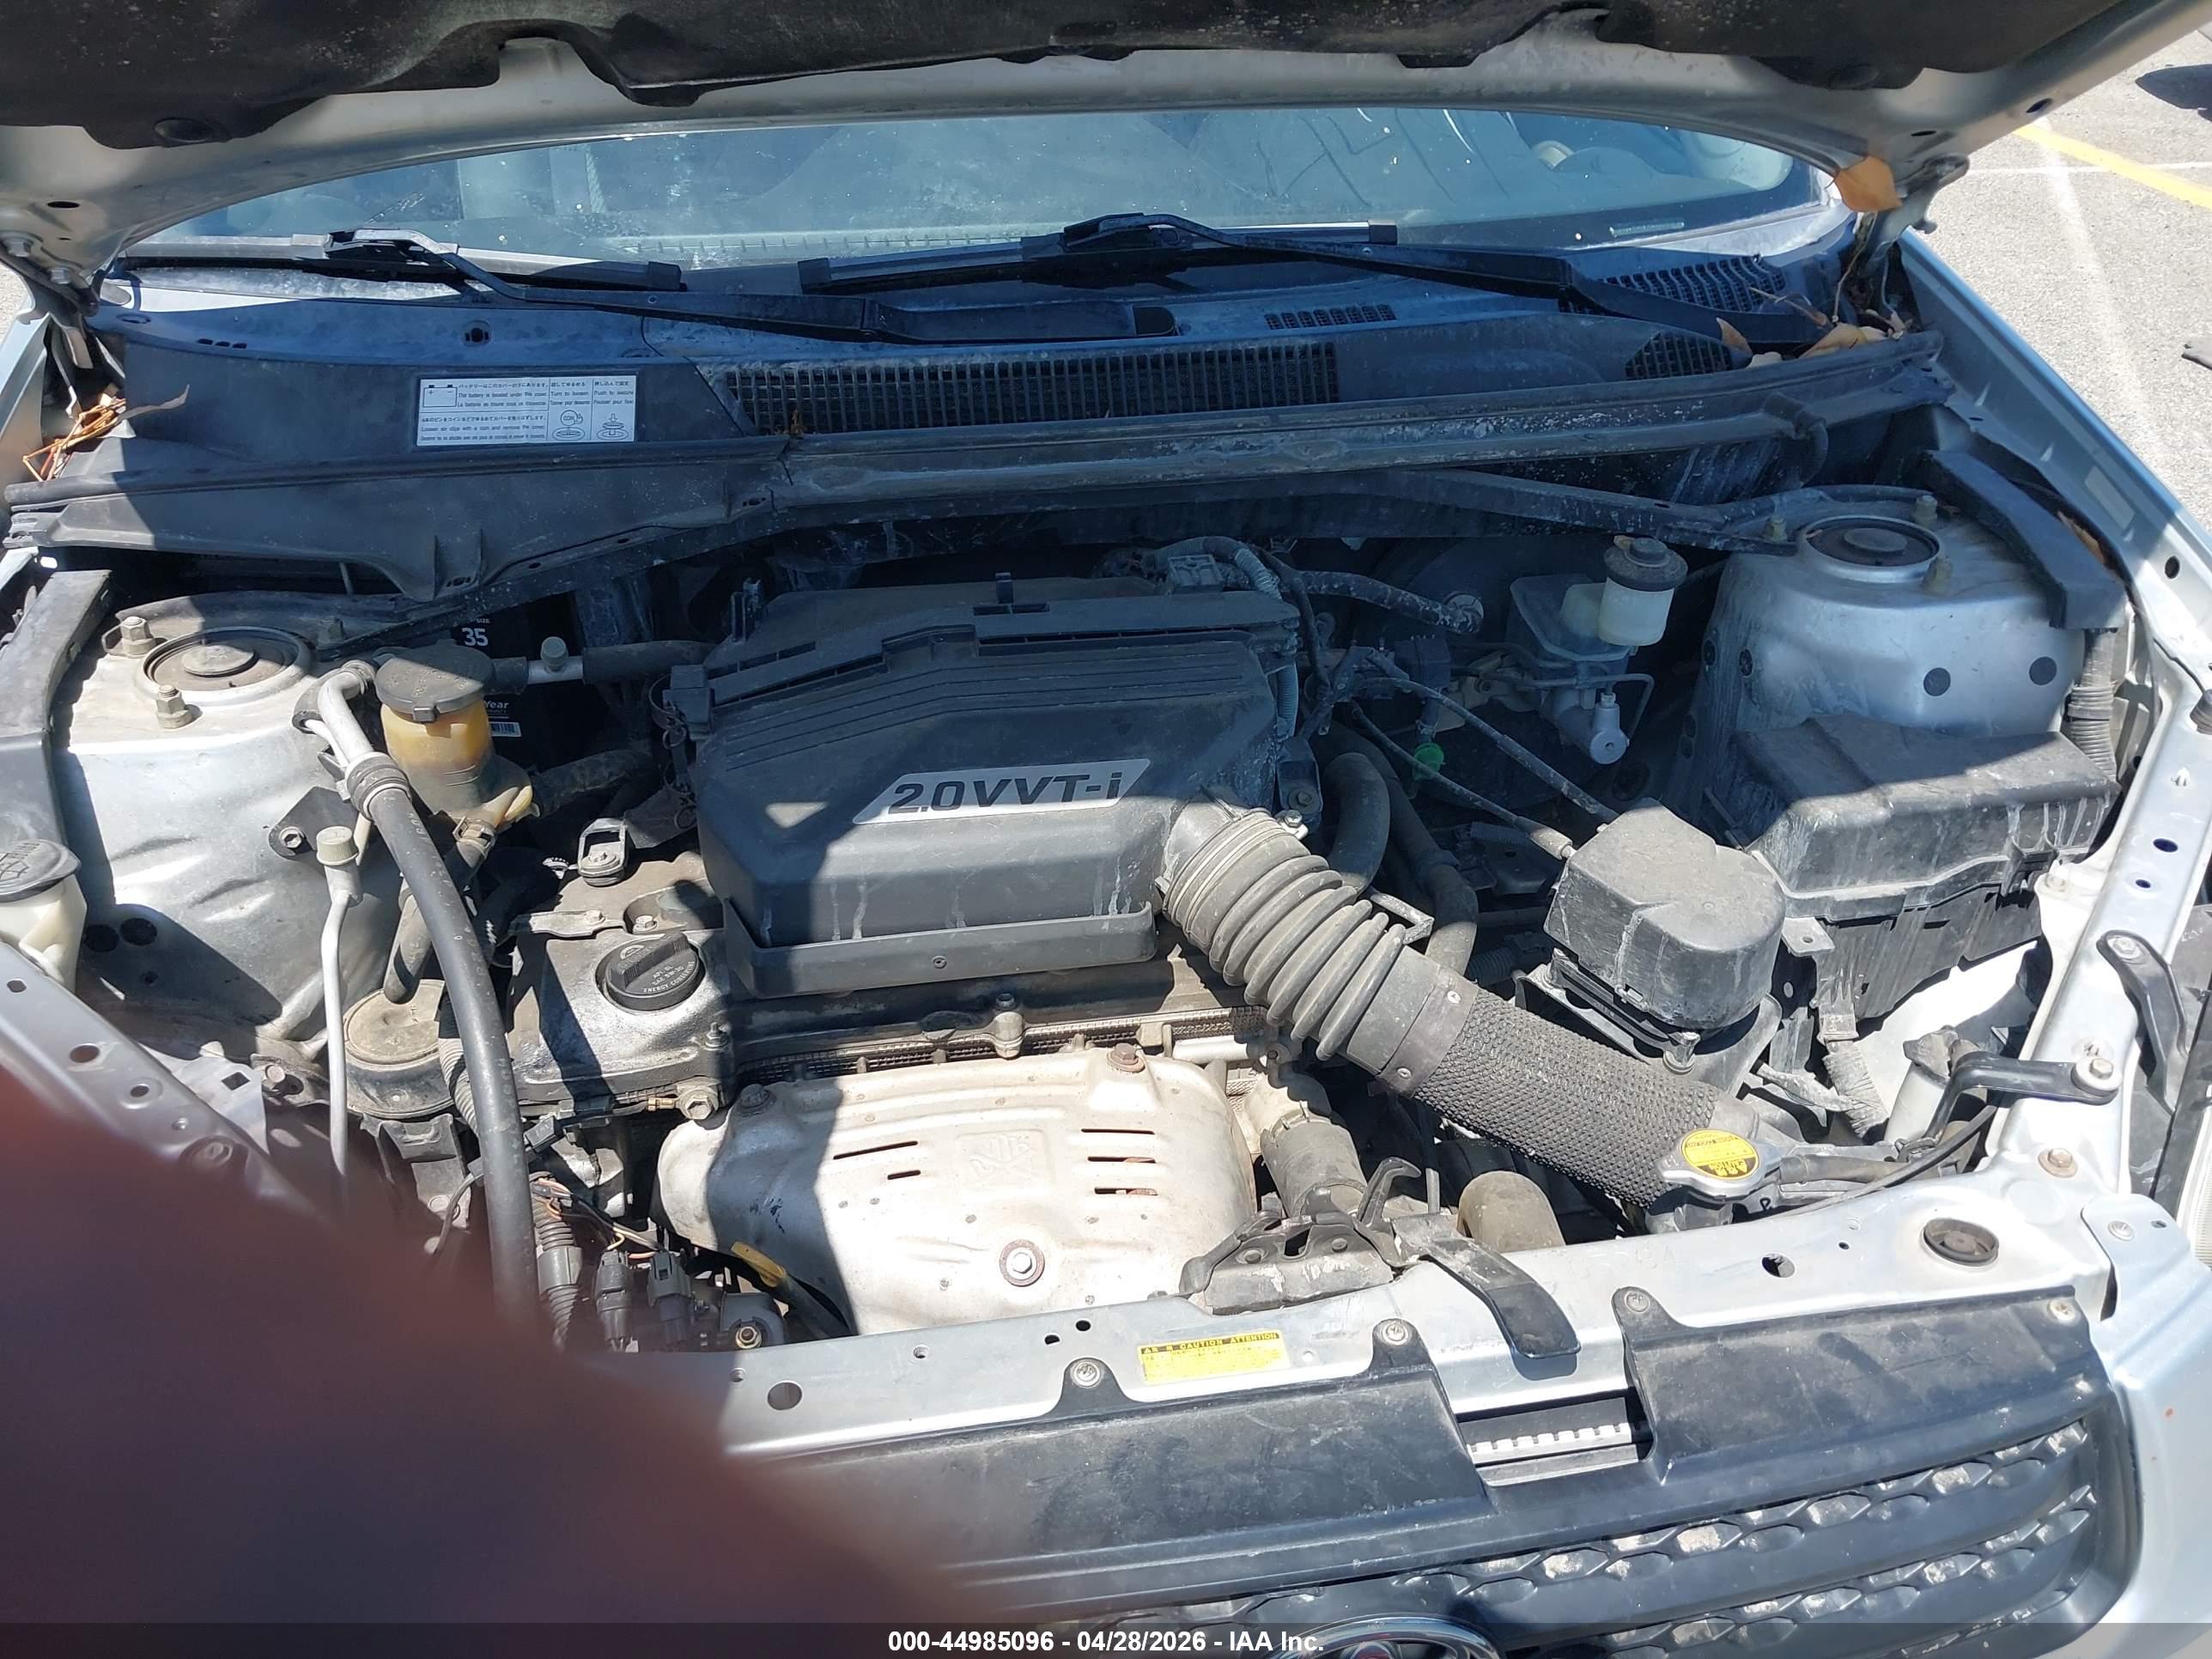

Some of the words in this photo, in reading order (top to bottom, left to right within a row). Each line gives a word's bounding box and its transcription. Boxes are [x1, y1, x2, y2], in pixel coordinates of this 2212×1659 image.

[462, 628, 489, 646] 35
[483, 701, 509, 709] Year
[643, 983, 669, 994] ENERGY
[1180, 1338, 1224, 1351] CAUTION
[1230, 1332, 1277, 1345] ATTENTION
